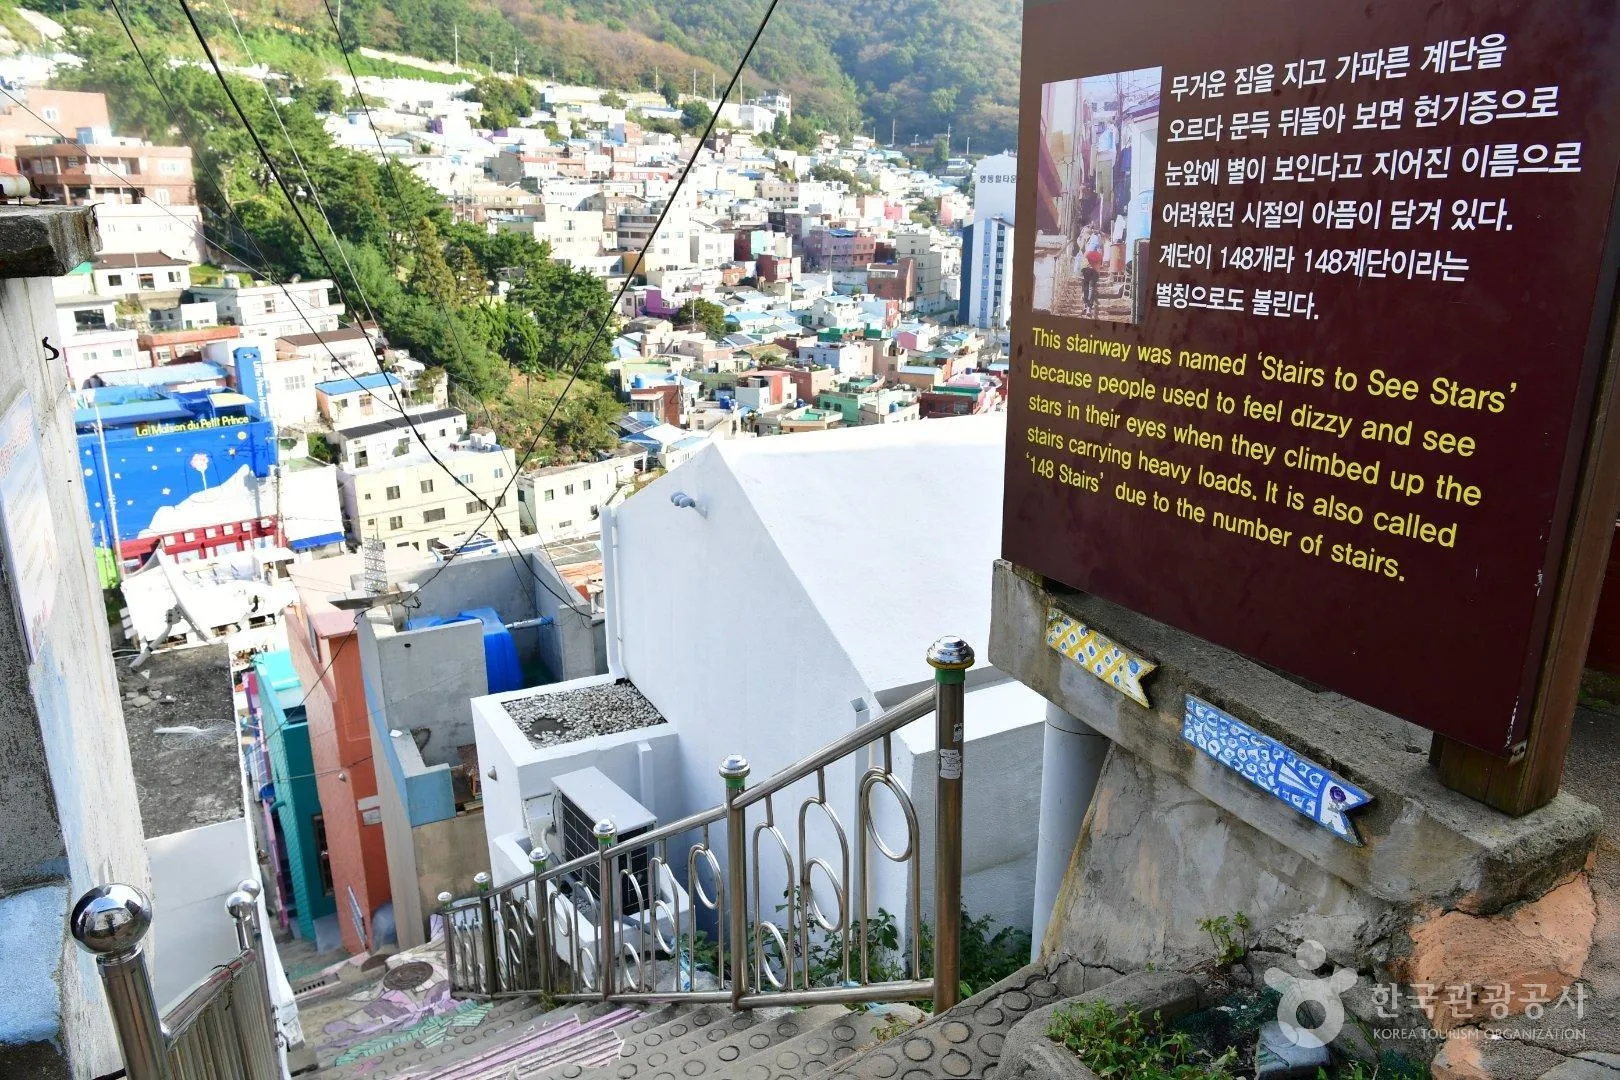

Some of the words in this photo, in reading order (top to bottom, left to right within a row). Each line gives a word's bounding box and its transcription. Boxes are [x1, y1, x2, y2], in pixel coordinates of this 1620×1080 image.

[1171, 70, 1226, 102] 무거운
[1234, 64, 1274, 95] 짐을
[1282, 59, 1326, 88] 지고
[1335, 46, 1410, 83] 가파른
[1421, 34, 1506, 73] 계단을
[1167, 115, 1223, 142] 오르다
[1230, 111, 1270, 140] 문득
[1278, 103, 1345, 136] 뒤돌아
[1353, 98, 1403, 129] 보면
[1415, 87, 1558, 127] 현기증으로
[1165, 159, 1219, 186] 눈앞에
[1228, 156, 1265, 184] 별이
[1273, 153, 1362, 182] 보인다고
[1372, 147, 1451, 180] 지어진
[1462, 143, 1581, 177] 이름으로
[1163, 202, 1234, 227] 어려웠던
[1242, 201, 1303, 228] 시절의
[1313, 200, 1381, 229] 아픔이
[1391, 199, 1441, 230] 담겨
[1451, 199, 1512, 231] 있다.
[1159, 243, 1211, 269] 계단이
[1221, 246, 1295, 273] 148개라
[1305, 248, 1469, 281] 148계단이라는
[1157, 283, 1244, 311] 별칭으로도
[1252, 289, 1318, 319] 불린다.
[1033, 327, 1060, 349] This
[1066, 334, 1131, 362] stairway
[1138, 346, 1171, 365] was
[1179, 352, 1246, 375] named
[1335, 367, 1357, 391] to
[1368, 370, 1418, 400] See
[136, 426, 148, 437] La
[151, 422, 186, 434] Maison
[187, 420, 199, 430] du
[200, 418, 220, 428] Petit
[222, 416, 249, 426] Prince
[1031, 360, 1092, 388] because
[1098, 376, 1155, 399] people
[1163, 387, 1209, 409] used
[1217, 392, 1235, 414] to
[1244, 395, 1282, 422] feel
[1291, 404, 1352, 438] dizzy
[1362, 421, 1412, 445] and
[1423, 431, 1475, 456] see
[1029, 395, 1061, 416] stars
[1068, 400, 1079, 420] in
[1086, 405, 1120, 428] their
[1127, 417, 1166, 439] eyes
[1174, 424, 1222, 451] when
[1232, 434, 1276, 465] they
[1284, 446, 1380, 484] climbed
[1391, 471, 1424, 496] up
[1437, 475, 1481, 506] the
[1028, 427, 1063, 449] stairs
[1069, 439, 1131, 469] carrying
[1139, 450, 1191, 484] heavy
[1199, 465, 1256, 500] loads.
[1266, 479, 1278, 503] It
[1287, 486, 1304, 510] is
[1313, 495, 1363, 524] also
[1372, 509, 1457, 548] called
[1116, 482, 1146, 505] due
[1153, 492, 1169, 512] to
[1177, 498, 1205, 522] the
[1213, 512, 1292, 546] number
[1301, 535, 1323, 556] of
[1331, 543, 1404, 581] stairs.
